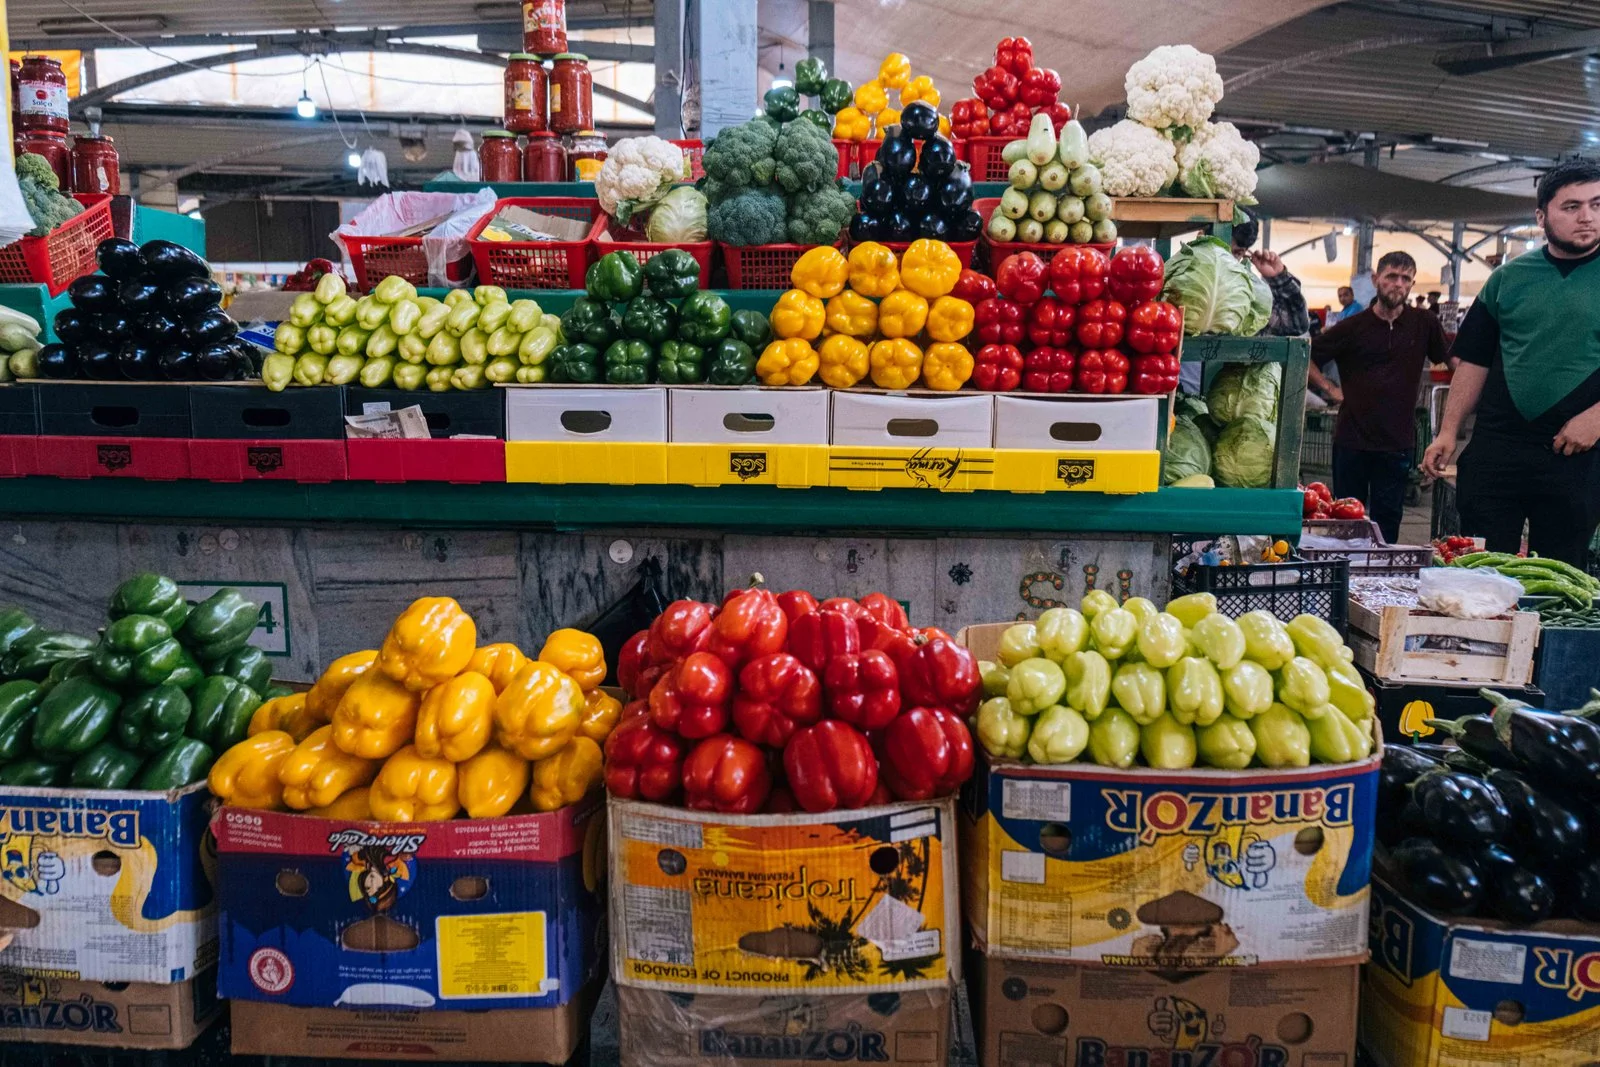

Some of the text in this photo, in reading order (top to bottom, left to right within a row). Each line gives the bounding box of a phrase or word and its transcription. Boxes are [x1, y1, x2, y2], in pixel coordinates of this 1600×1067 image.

[731, 458, 767, 473] SGS
[906, 458, 960, 480] Karma
[1059, 464, 1092, 478] SGS
[328, 830, 425, 855] Sherezada
[698, 868, 794, 882] PREMIUM BANANAS
[694, 865, 866, 910] Tropicana
[634, 963, 790, 982] PRODUCT OF ECUADOR
